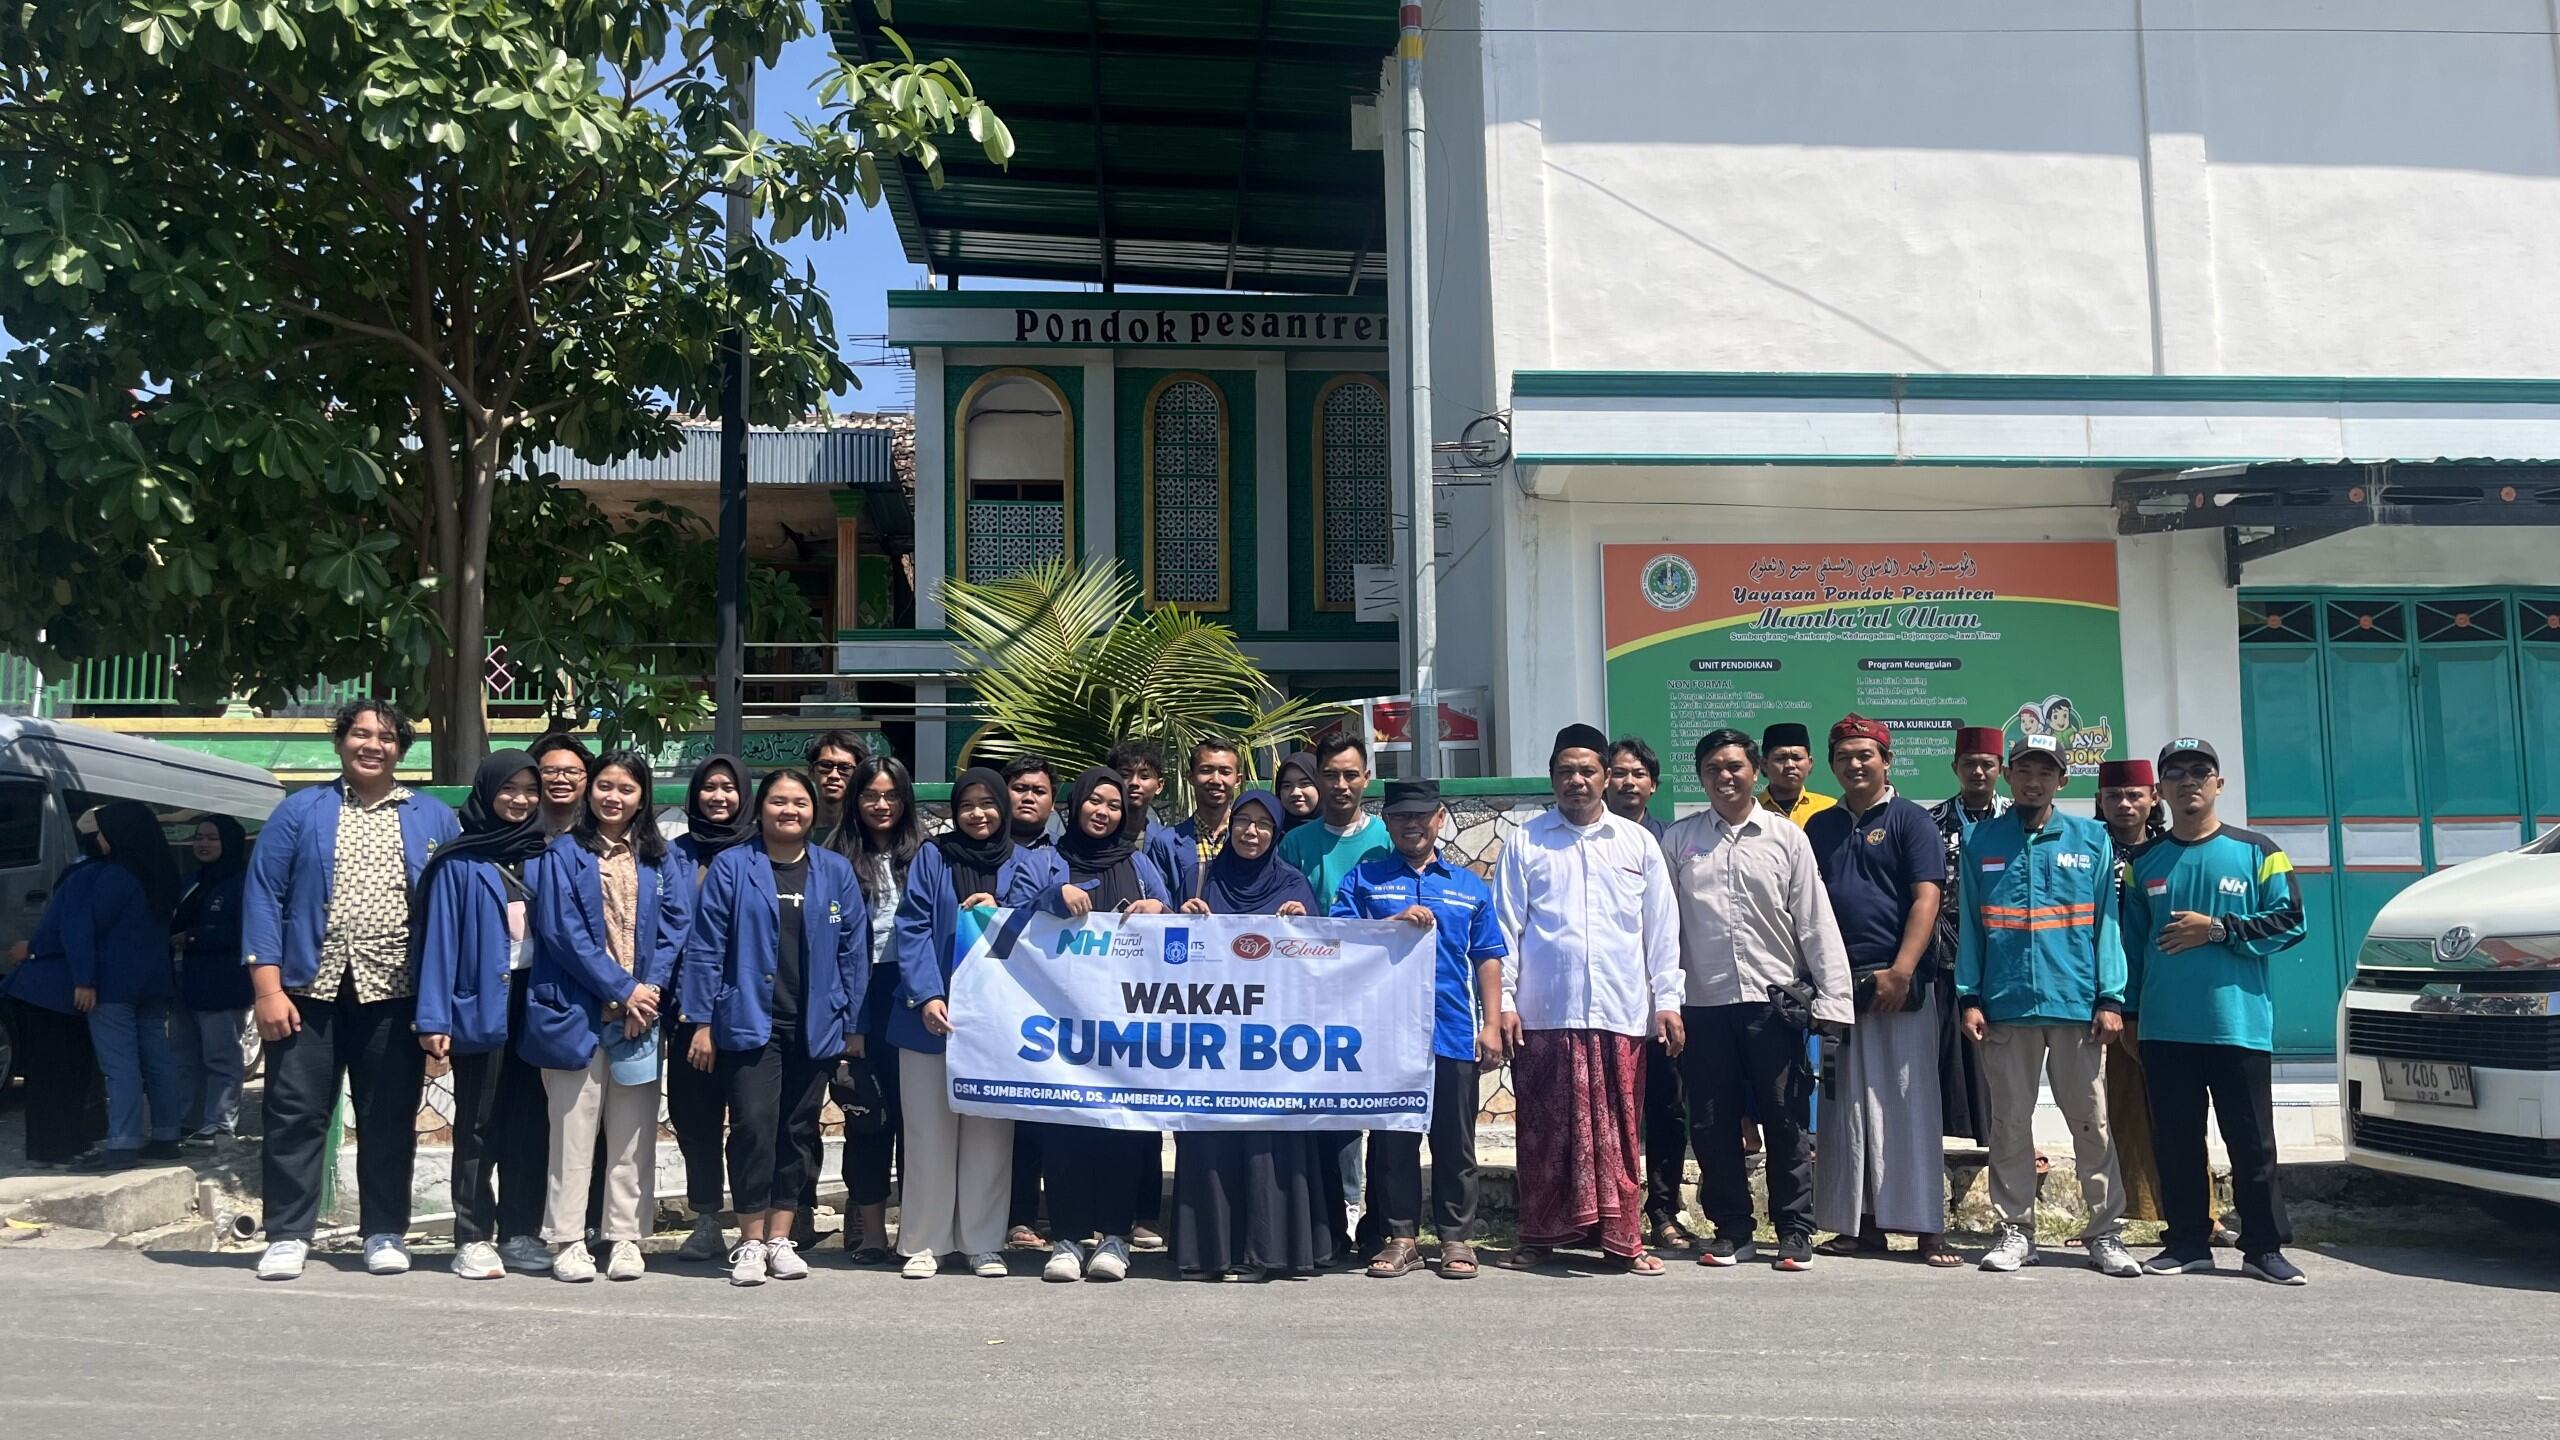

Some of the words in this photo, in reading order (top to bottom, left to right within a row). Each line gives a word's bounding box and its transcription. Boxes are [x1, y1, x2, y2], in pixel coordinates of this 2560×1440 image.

[1015, 308, 1177, 343] Pondok
[1733, 586, 1816, 604] Yayasan
[1823, 586, 1894, 601] Pondok
[1902, 586, 1995, 601] Pesantren
[1749, 606, 1892, 630] Mamba'ul
[1896, 606, 1982, 630] Ulum
[1730, 632, 1788, 642] Sumbergirang
[1794, 632, 1836, 642] Jamberejo
[1842, 632, 1895, 642] Kedungadem
[1902, 632, 1949, 642] Bojonegoro
[1955, 632, 1976, 641] Jawa
[1977, 632, 2001, 641] Timur
[1699, 661, 1718, 669] UNIT
[1721, 661, 1773, 669] PENDIDIKAN
[1868, 660, 1902, 670] Program
[1904, 660, 1952, 670] Keunggulan
[1667, 680, 1690, 689] NON
[1692, 680, 1734, 689] FORMAL
[1906, 720, 1953, 729] KURIKULER
[2072, 716, 2108, 749] Ayo!
[2057, 852, 2079, 868] NH
[2218, 876, 2248, 894] NH
[829, 914, 841, 924] ITS
[1056, 928, 1112, 957] NH
[1113, 936, 1143, 946] nurul
[1190, 941, 1205, 950] ITS
[1275, 938, 1336, 958] Elvita
[1111, 947, 1144, 959] hayat
[1121, 982, 1265, 1015] WAKAF
[1017, 1015, 1226, 1070] SUMUR
[1240, 1023, 1363, 1072] BOR
[2401, 1062, 2438, 1088] 7406
[2447, 1066, 2469, 1091] DH
[954, 1083, 981, 1095] DSN.
[983, 1085, 1083, 1103] SUMBERGIRANG,
[1086, 1091, 1105, 1103] DS.
[1108, 1092, 1184, 1108] JAMBEREJO,
[1187, 1095, 1213, 1107] KEC.
[1216, 1096, 1306, 1110] KEDUNGADEM,
[1309, 1098, 1337, 1109] KAB.
[1340, 1096, 1425, 1109] BOJONEGORO
